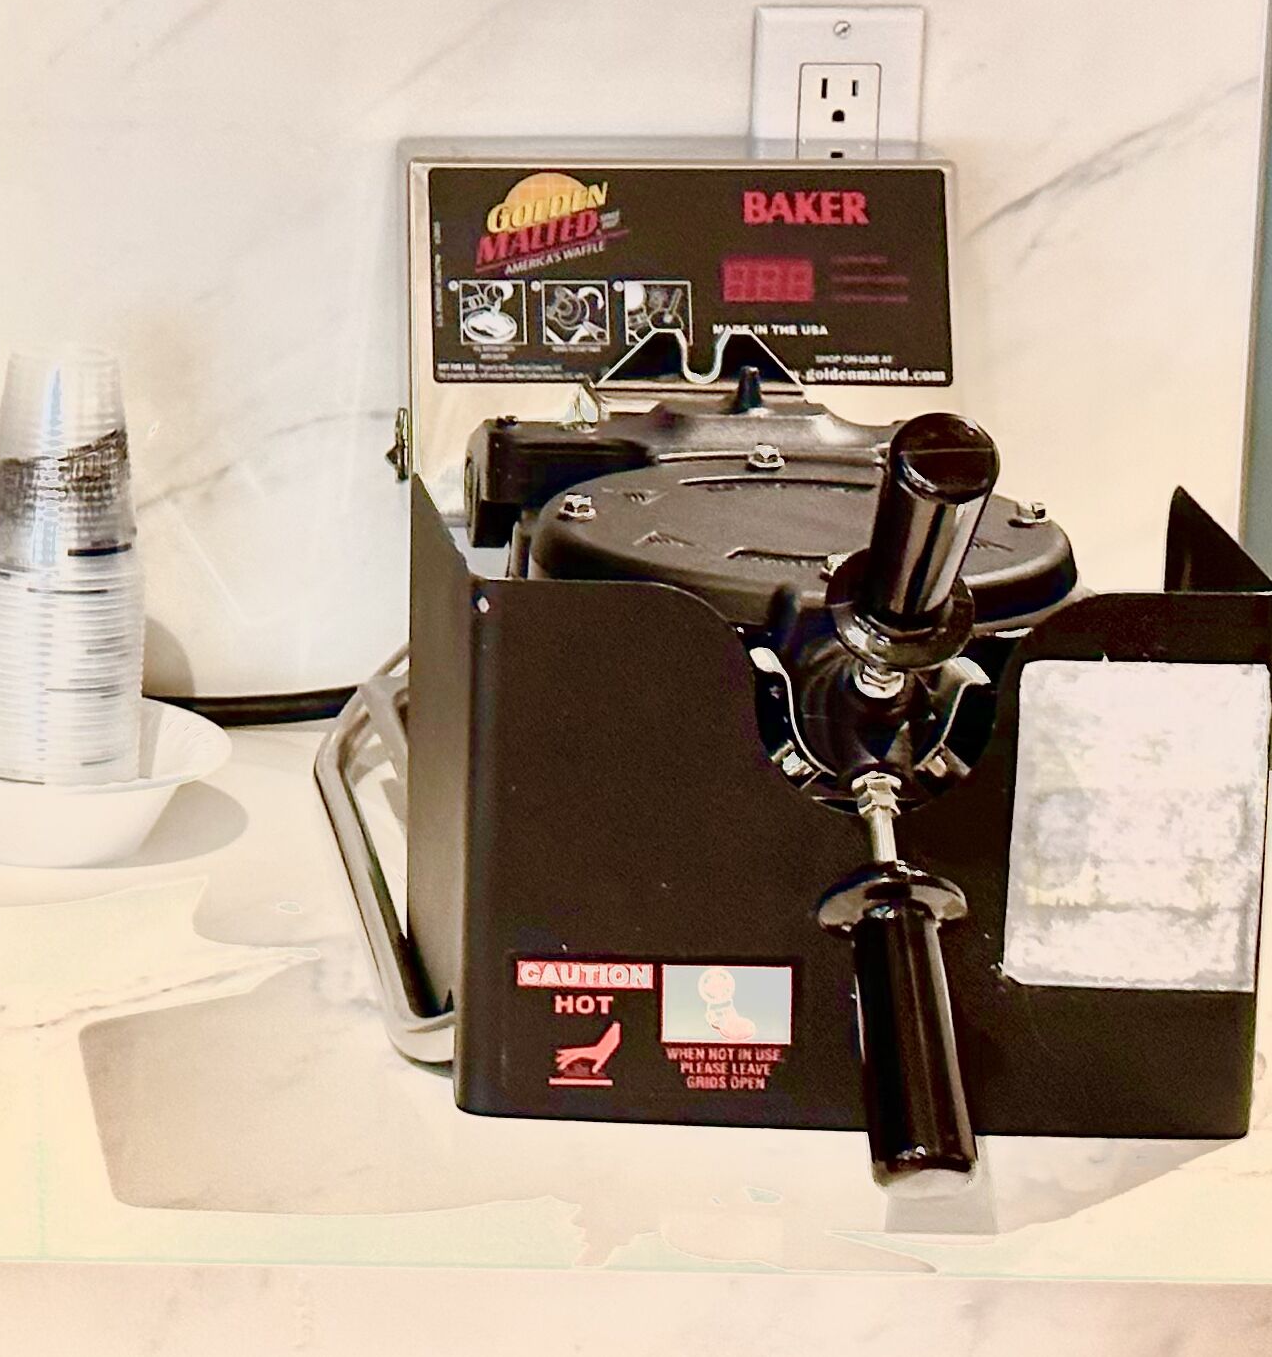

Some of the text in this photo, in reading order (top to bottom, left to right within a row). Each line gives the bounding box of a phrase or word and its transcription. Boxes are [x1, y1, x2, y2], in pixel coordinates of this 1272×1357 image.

[487, 181, 608, 233] GOLDEN
[742, 191, 869, 225] BAKER
[477, 209, 598, 266] MALTED
[563, 241, 605, 261] WAFFLE
[712, 324, 829, 335] MADE IN THE USA
[815, 355, 841, 364] SHOP
[881, 355, 894, 363] AT
[519, 963, 650, 986] CAUTION
[555, 995, 614, 1014] HOT
[665, 1047, 781, 1062] WHEN NOT IN USE
[680, 1062, 772, 1076] PLEASE LEAVE
[686, 1075, 766, 1089] GRIDS OPEN
